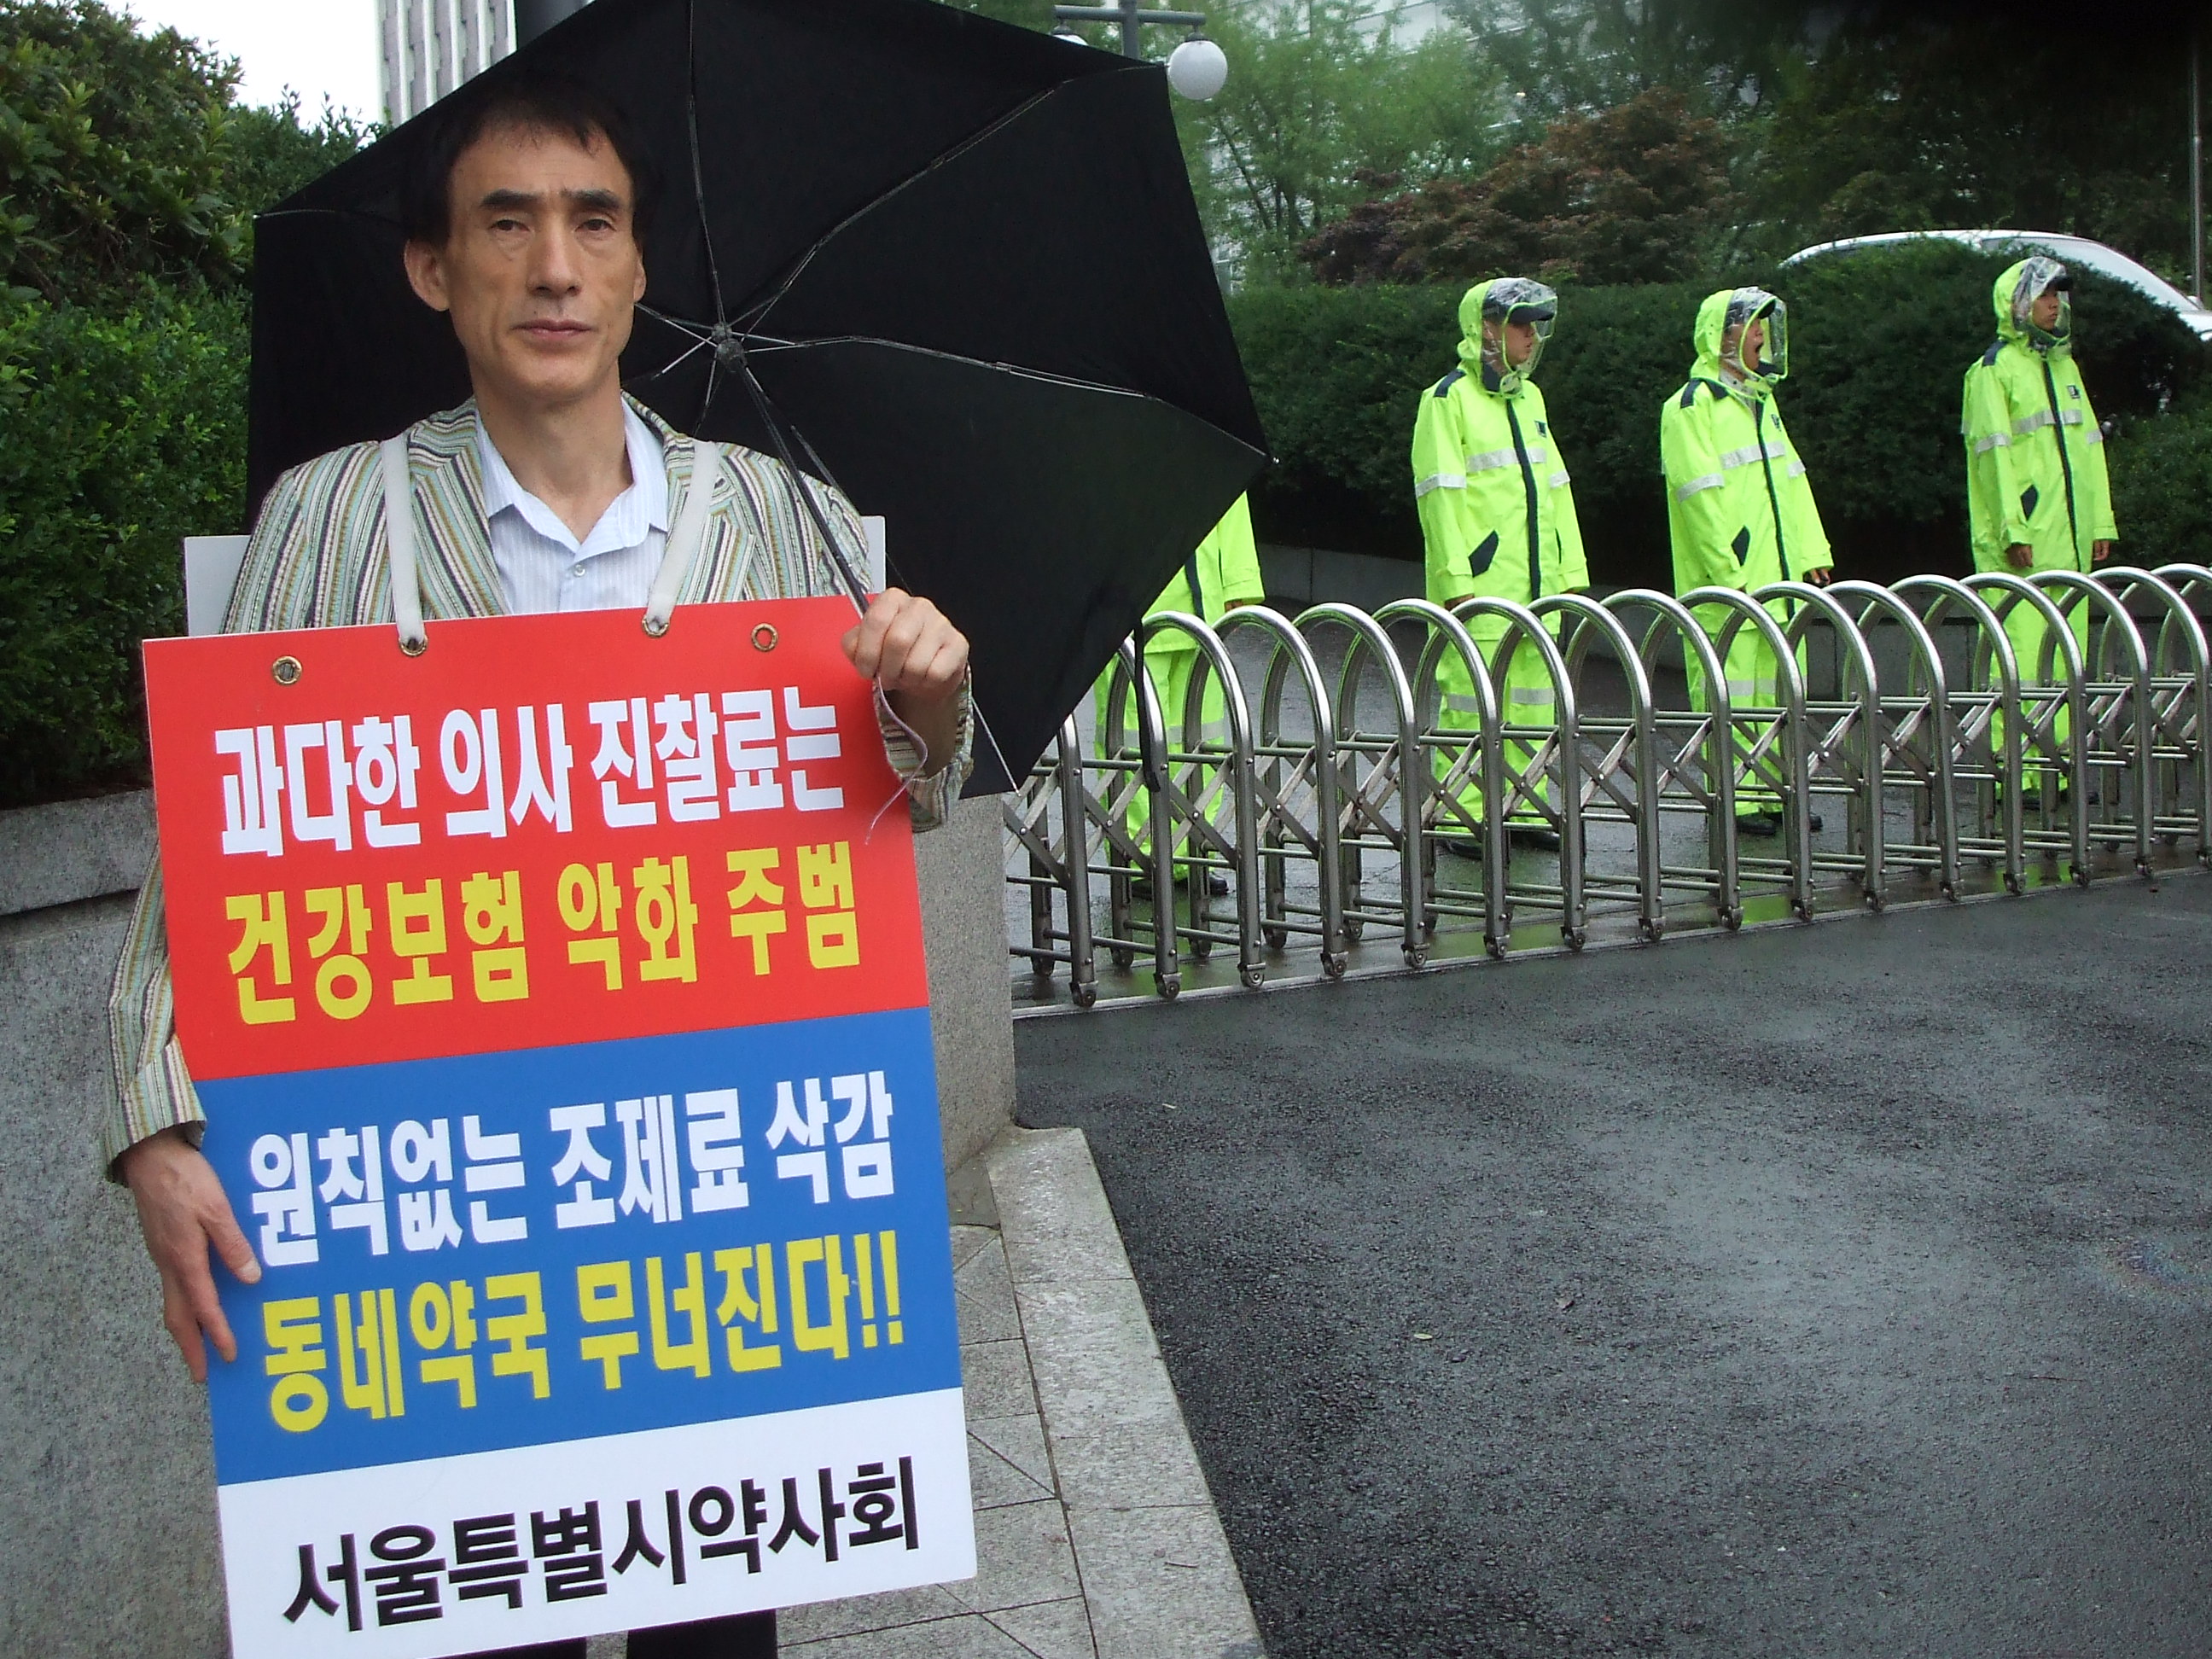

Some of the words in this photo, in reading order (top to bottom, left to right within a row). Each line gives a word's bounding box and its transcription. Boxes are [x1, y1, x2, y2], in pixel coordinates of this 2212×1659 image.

[215, 715, 421, 856] 과다한
[440, 704, 573, 837] 의사
[589, 687, 843, 828] 진찰료는
[226, 871, 528, 1024] 건강보험
[558, 856, 697, 990] 악화
[727, 841, 859, 975] 주범
[249, 1115, 527, 1266] 원칙없는
[550, 1089, 748, 1228] 조제료
[766, 1071, 894, 1203] 삭감
[264, 1272, 550, 1431] 동네약국
[577, 1231, 902, 1388] 무너진다!!
[283, 1458, 919, 1632] 서울특별시약사회
